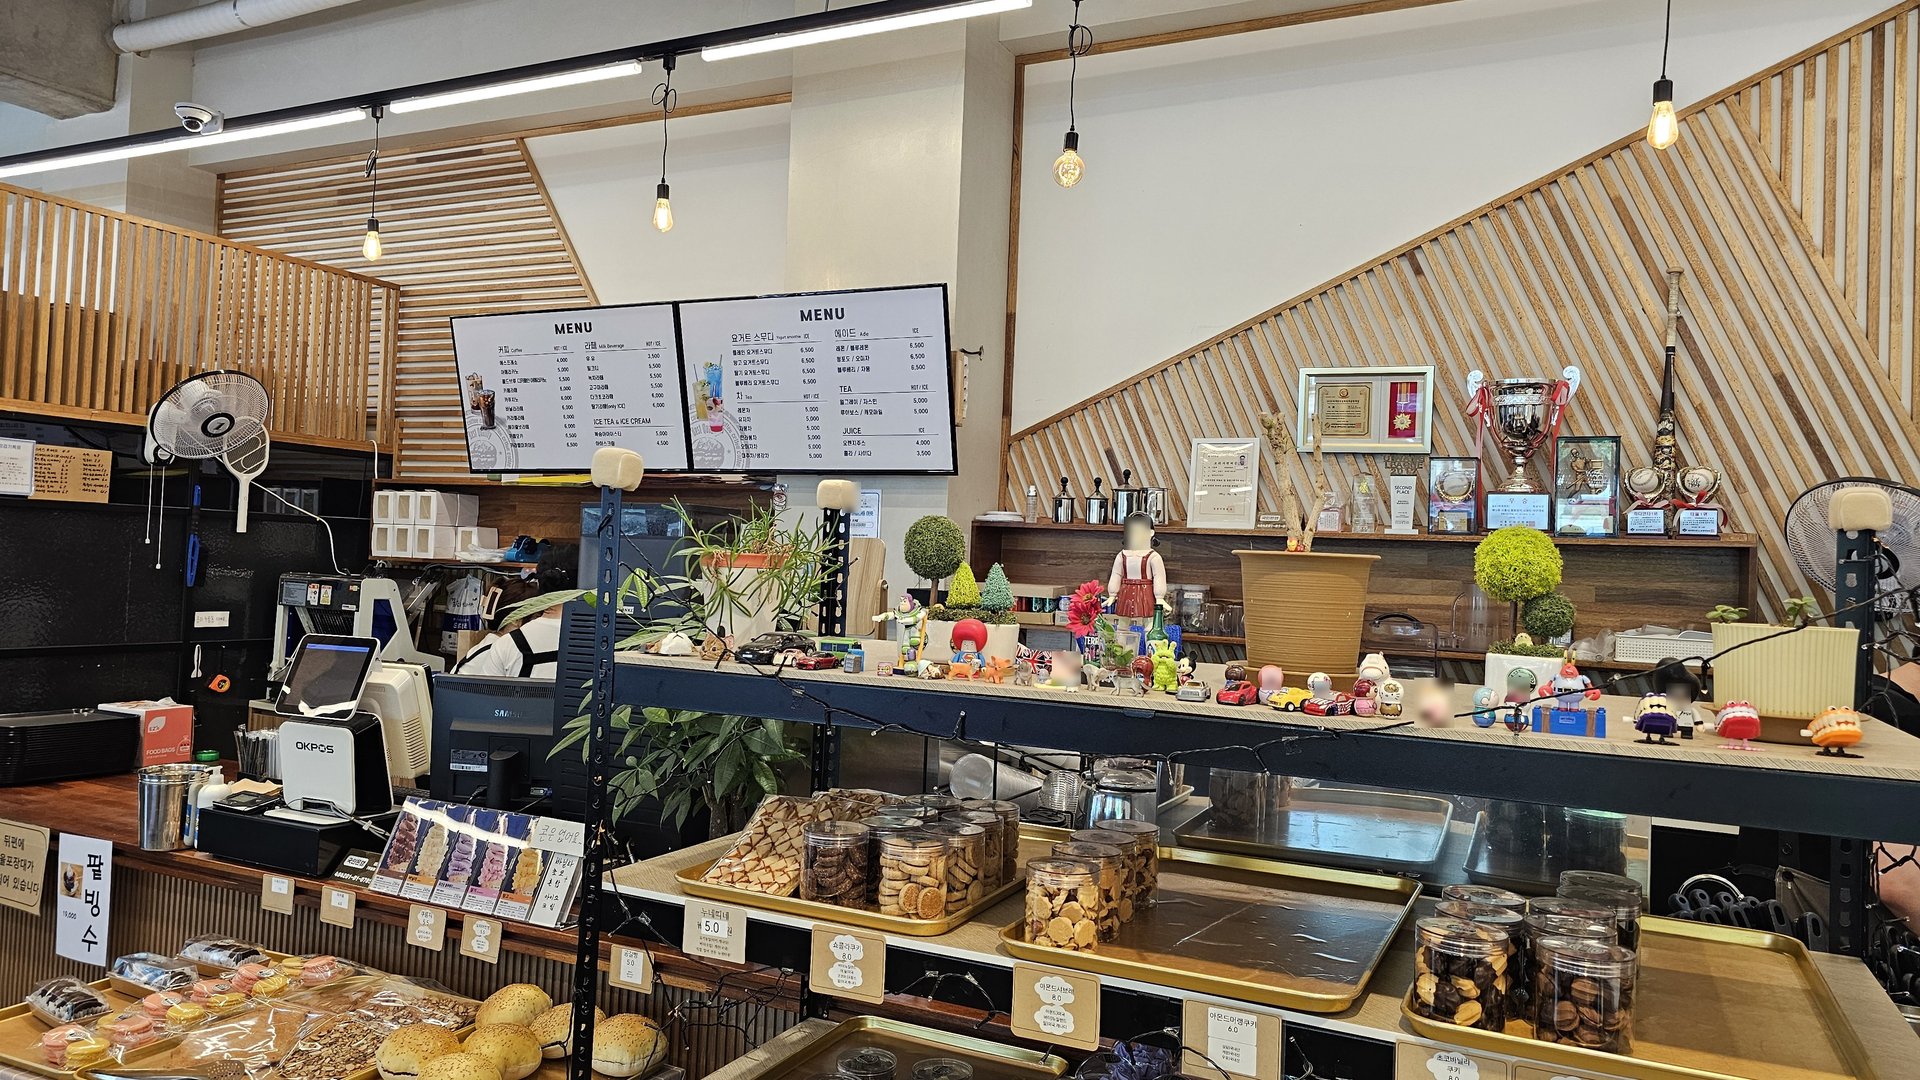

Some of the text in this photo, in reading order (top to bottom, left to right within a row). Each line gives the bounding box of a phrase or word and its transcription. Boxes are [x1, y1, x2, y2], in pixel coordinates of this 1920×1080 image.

[800, 308, 845, 322] MENU
[554, 322, 592, 334] MENU
[834, 328, 856, 338] 에이드
[732, 334, 751, 342] 요거트
[754, 332, 774, 341] 스무디
[296, 741, 334, 754] OKPOS
[4, 835, 24, 850] 뒤편에
[13, 876, 39, 896] 있습니다
[82, 854, 104, 952] 팥빙수
[705, 921, 719, 933] 5.0
[1210, 1012, 1257, 1028] 아몬드머랭쿠키
